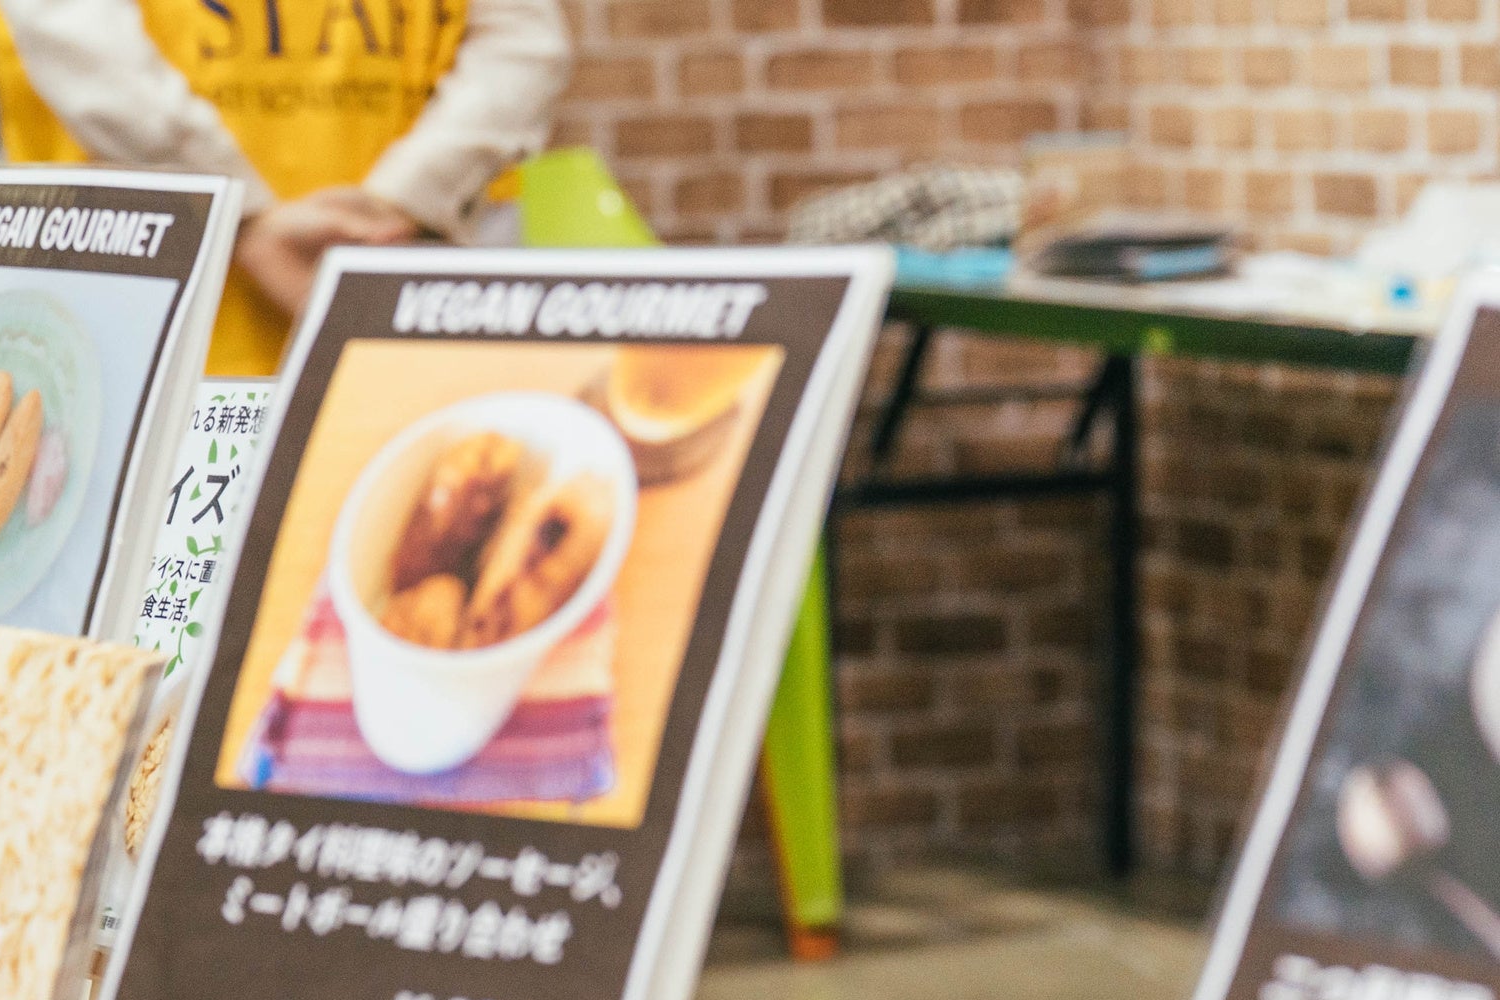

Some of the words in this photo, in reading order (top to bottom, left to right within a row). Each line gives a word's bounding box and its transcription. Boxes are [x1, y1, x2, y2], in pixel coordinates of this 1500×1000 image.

[39, 207, 175, 259] GOURMET
[140, 594, 188, 623] 食生活。
